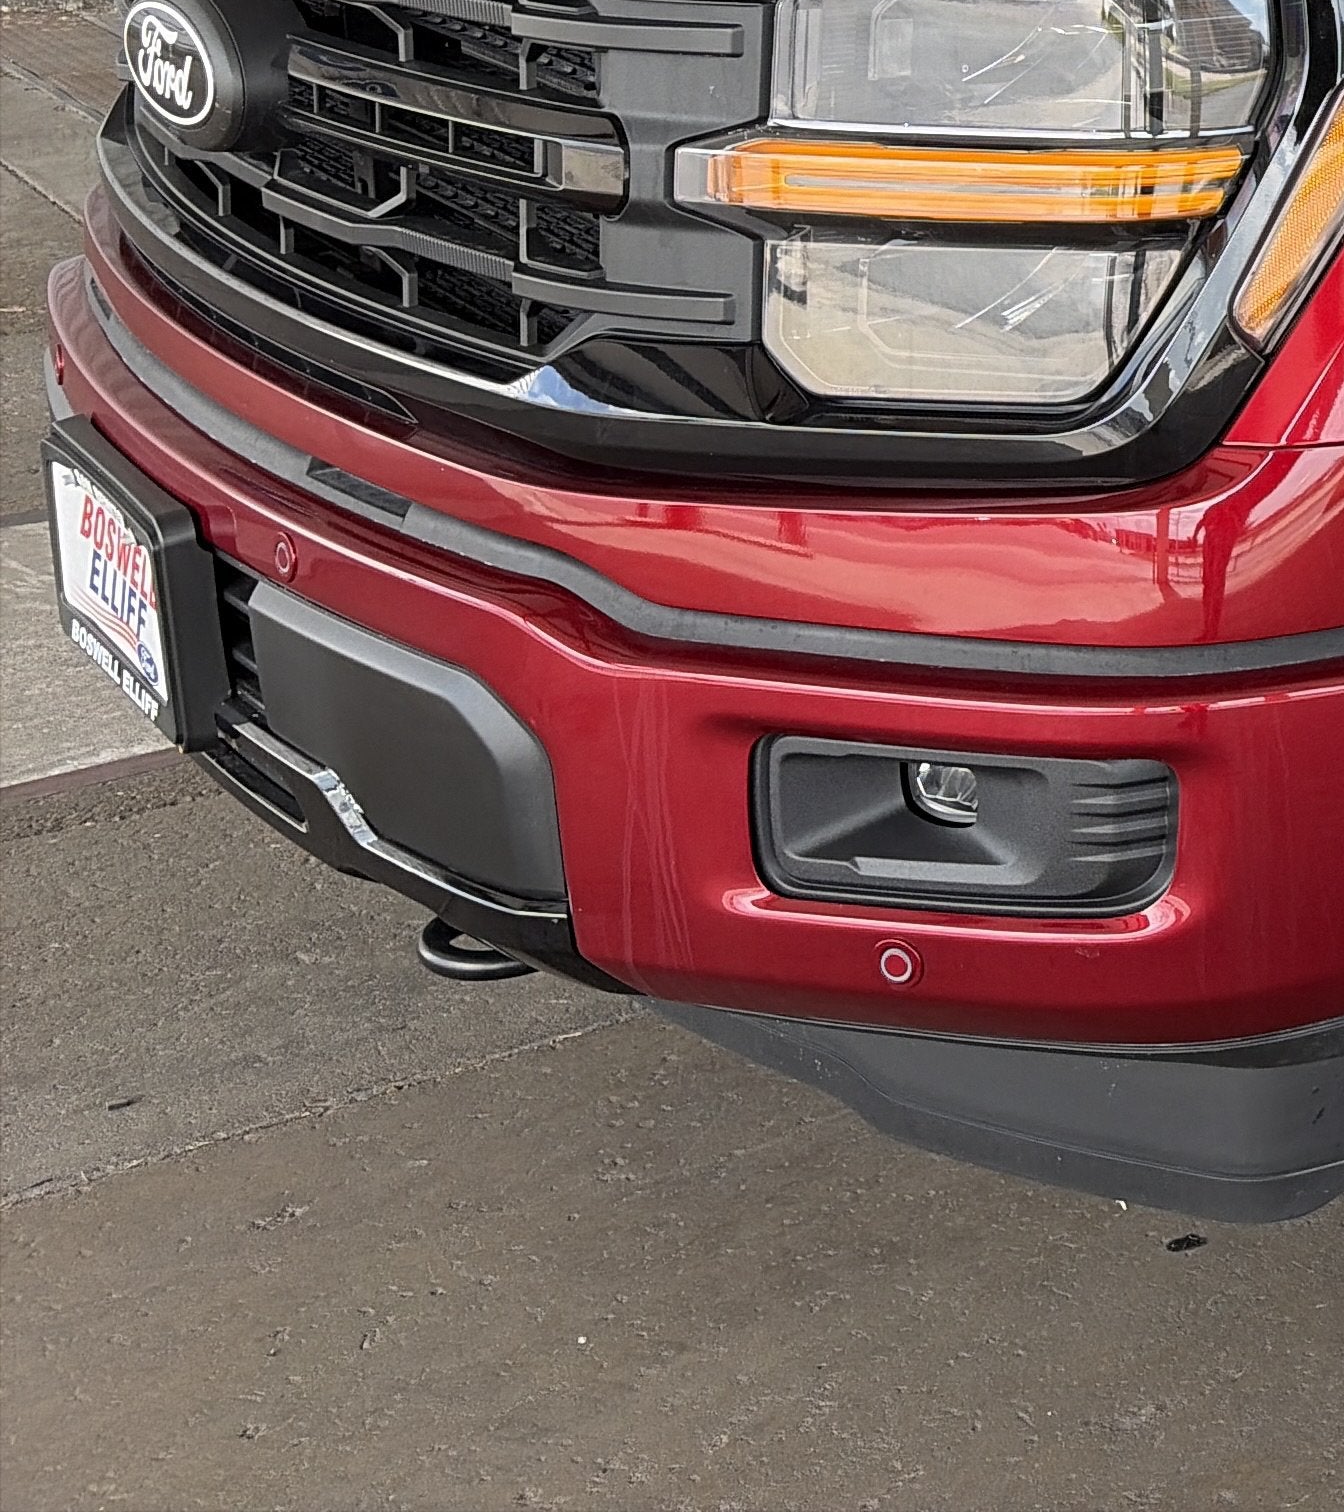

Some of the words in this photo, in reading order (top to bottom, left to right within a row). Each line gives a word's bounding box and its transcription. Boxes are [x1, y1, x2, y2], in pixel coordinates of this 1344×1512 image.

[138, 14, 193, 110] Ford
[89, 548, 148, 642] ELLIFF
[71, 618, 121, 686] BOSWELL
[121, 668, 159, 723] ELLIFF
